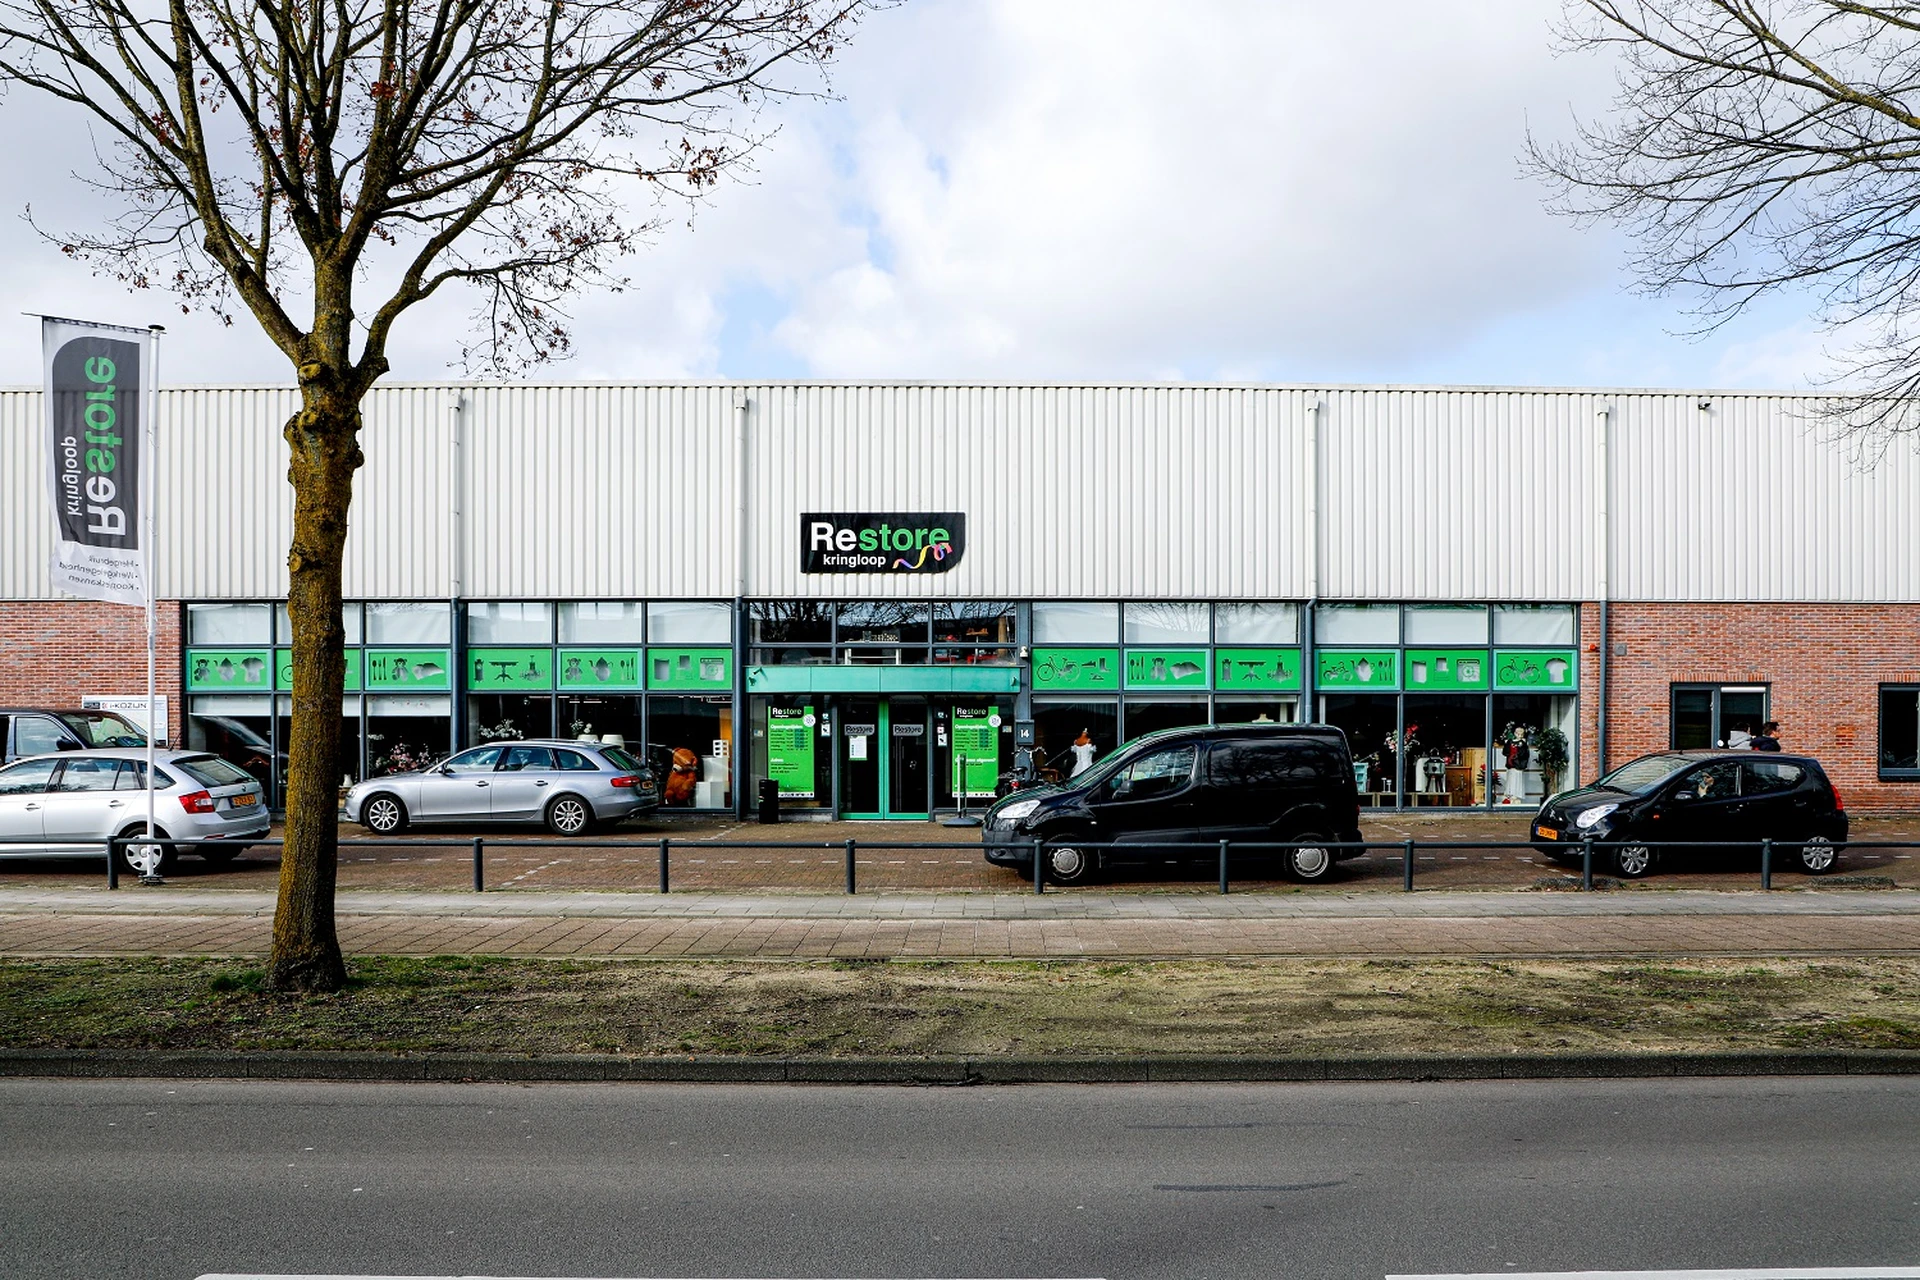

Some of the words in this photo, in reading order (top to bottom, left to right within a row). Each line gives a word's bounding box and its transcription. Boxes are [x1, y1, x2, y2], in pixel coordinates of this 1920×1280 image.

[810, 522, 950, 551] Restore
[823, 553, 887, 568] kringloop
[772, 707, 802, 715] Restore
[956, 707, 987, 715] Restore
[1020, 729, 1030, 738] 14
